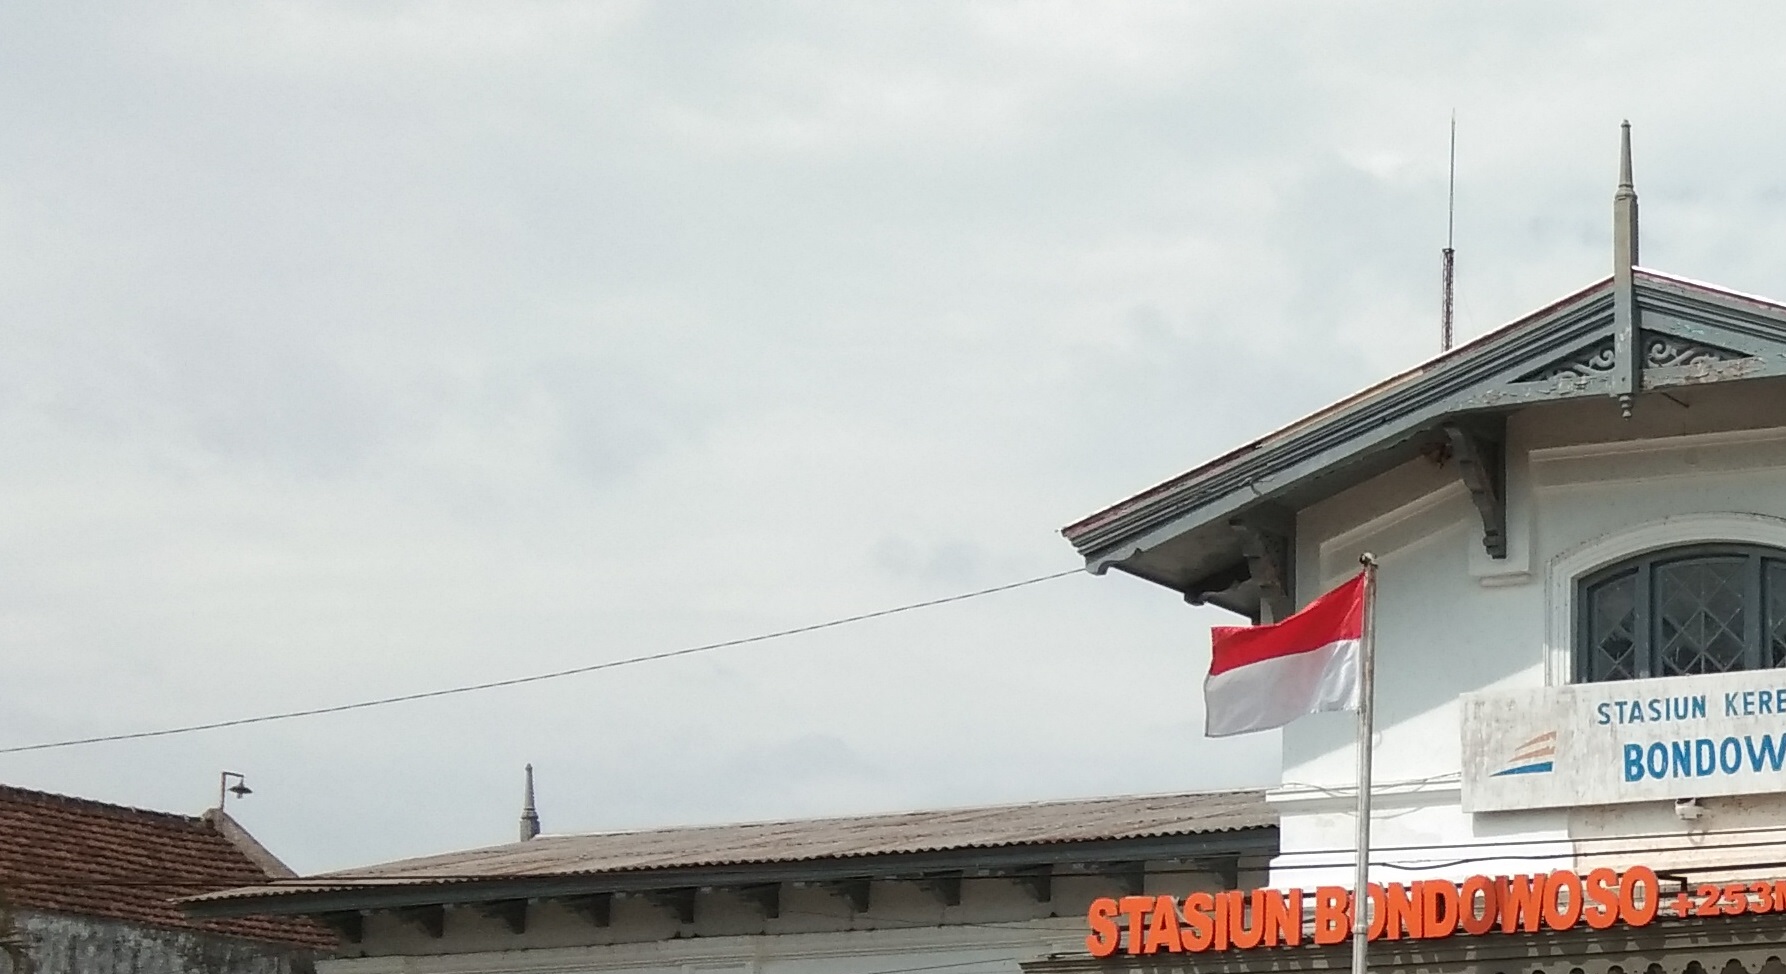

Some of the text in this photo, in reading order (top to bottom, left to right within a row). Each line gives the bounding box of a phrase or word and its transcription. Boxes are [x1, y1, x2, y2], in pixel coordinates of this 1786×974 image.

[1597, 694, 1706, 725] STASIUN
[1086, 888, 1303, 958] STASIUN
[1313, 866, 1660, 945] BONDOWOSO
